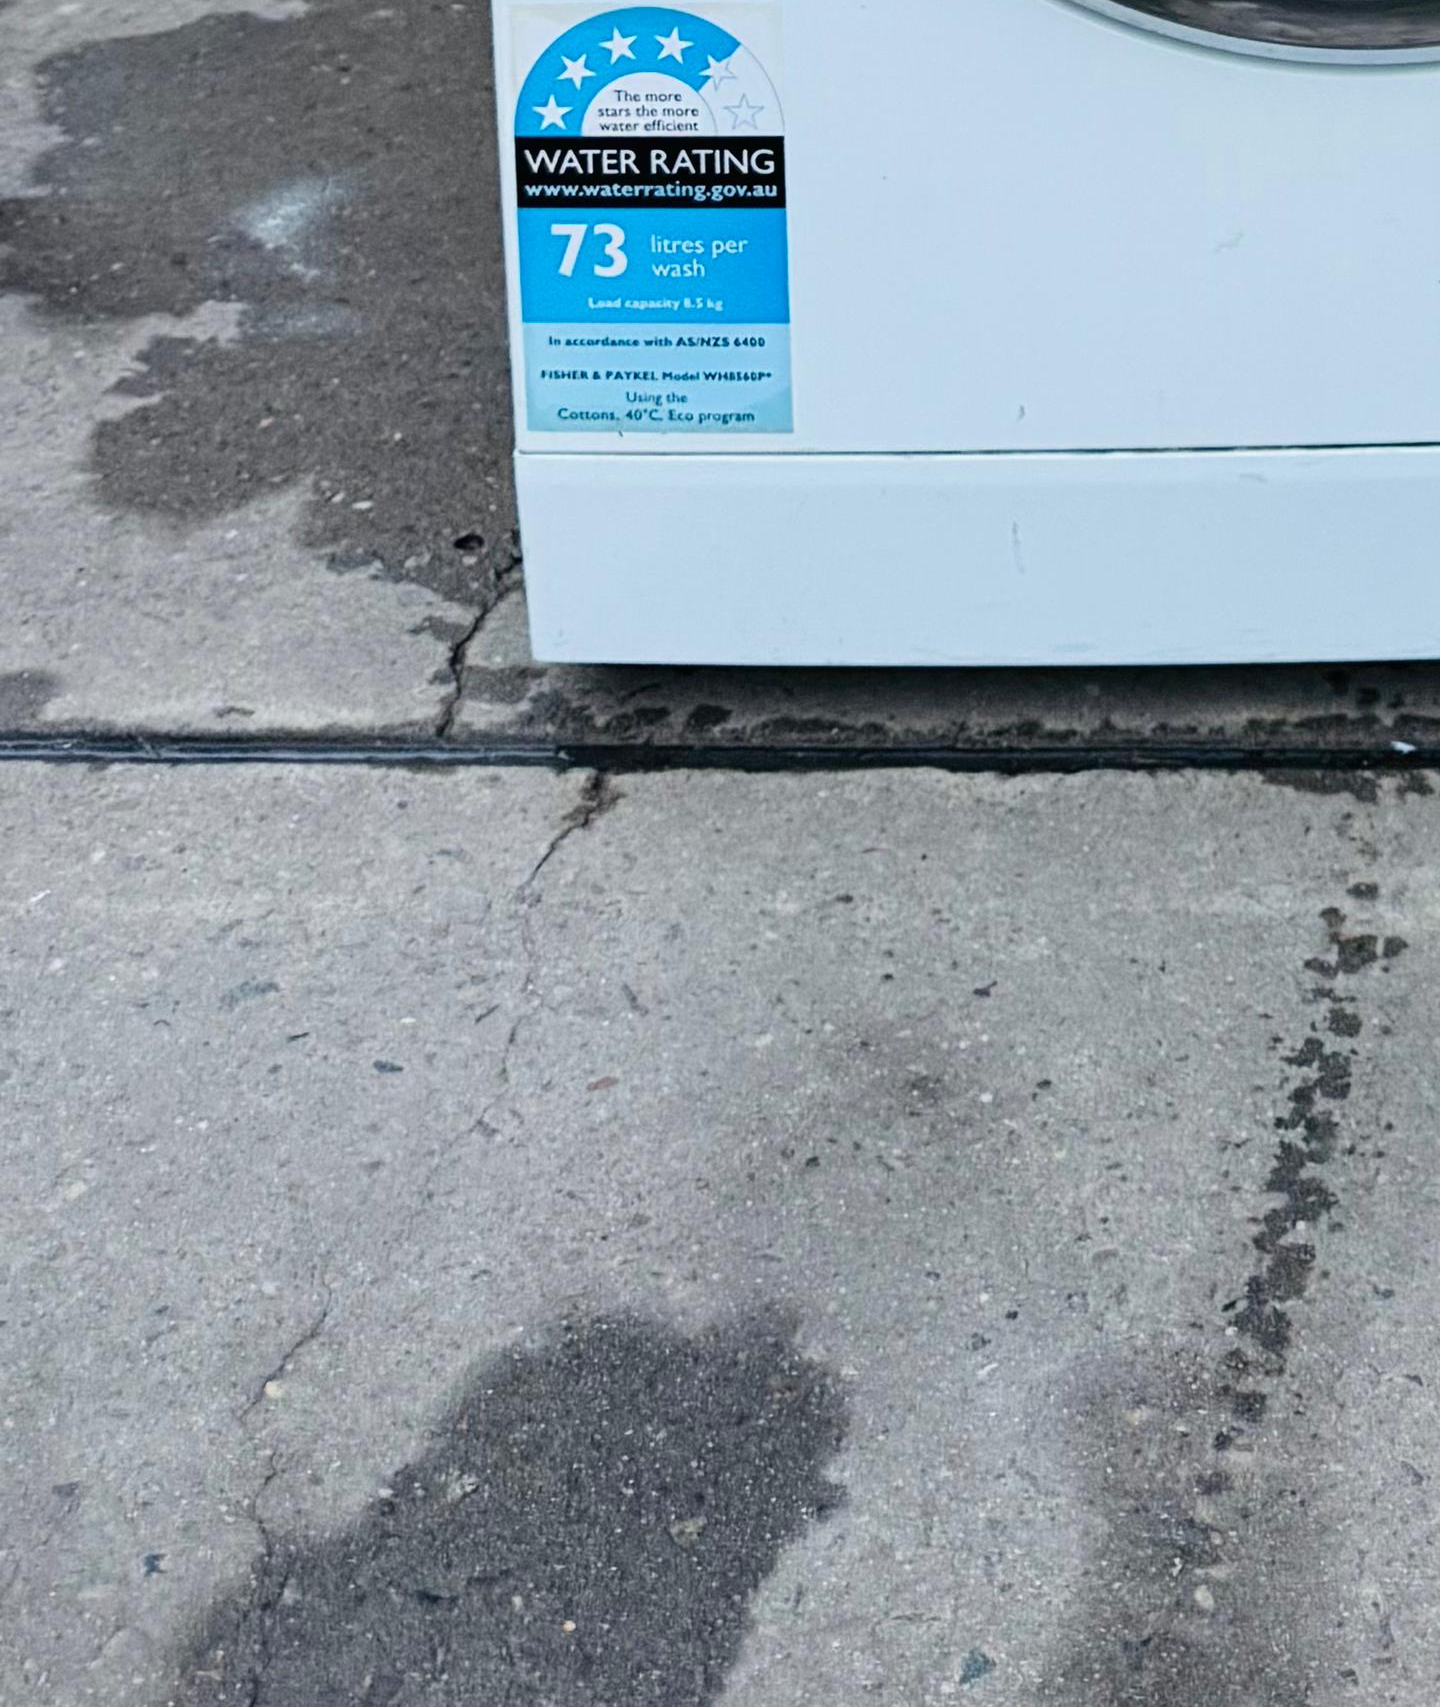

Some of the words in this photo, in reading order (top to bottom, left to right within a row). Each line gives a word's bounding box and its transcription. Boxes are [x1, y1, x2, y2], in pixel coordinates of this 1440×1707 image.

[614, 89, 642, 102] The
[645, 92, 682, 102] more
[598, 107, 631, 117] stars
[635, 105, 659, 117] the
[663, 107, 699, 117] more
[600, 121, 639, 132] water
[644, 119, 699, 132] efficient
[524, 149, 640, 175] WATER
[650, 149, 775, 175] RATING
[525, 181, 777, 201] www.waterrating.gov.au
[551, 223, 628, 278] 73
[651, 235, 705, 253] litres
[711, 238, 748, 258] per
[652, 259, 705, 277] wash
[588, 297, 621, 308] Load
[625, 298, 679, 311] capacity
[706, 297, 724, 311] kg
[549, 337, 561, 346] In
[565, 336, 639, 347] accordance
[643, 336, 672, 347] with
[676, 336, 730, 347] AS/NZS
[541, 369, 588, 380] FISHER
[592, 369, 601, 380] &
[605, 369, 657, 380] PAYKEL
[662, 369, 700, 380] Model
[626, 391, 662, 406] Using
[666, 391, 688, 403] the
[668, 409, 693, 421] Eco
[699, 411, 755, 424] program
